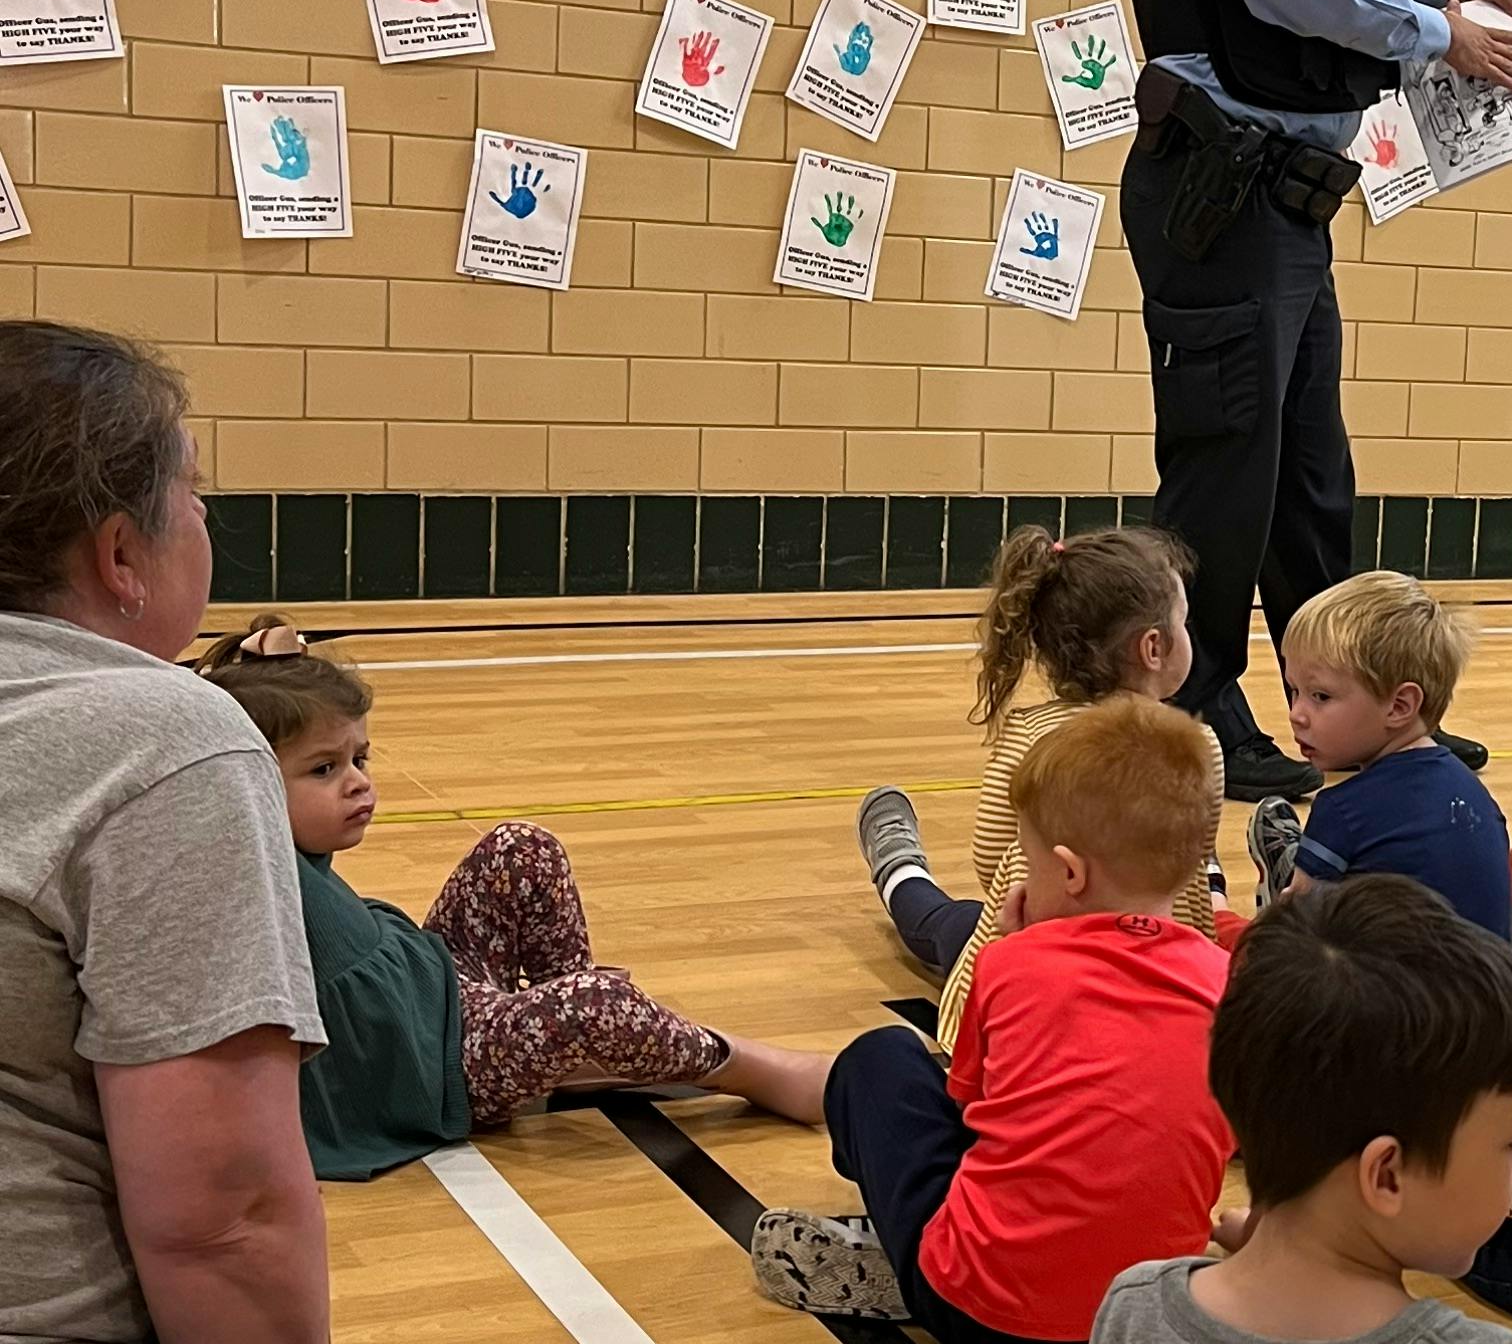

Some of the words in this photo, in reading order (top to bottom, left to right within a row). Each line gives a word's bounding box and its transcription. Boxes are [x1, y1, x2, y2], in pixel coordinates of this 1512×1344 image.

[0, 19, 33, 28] Officer
[46, 35, 95, 46] THANKS!
[426, 31, 469, 42] THANKS!
